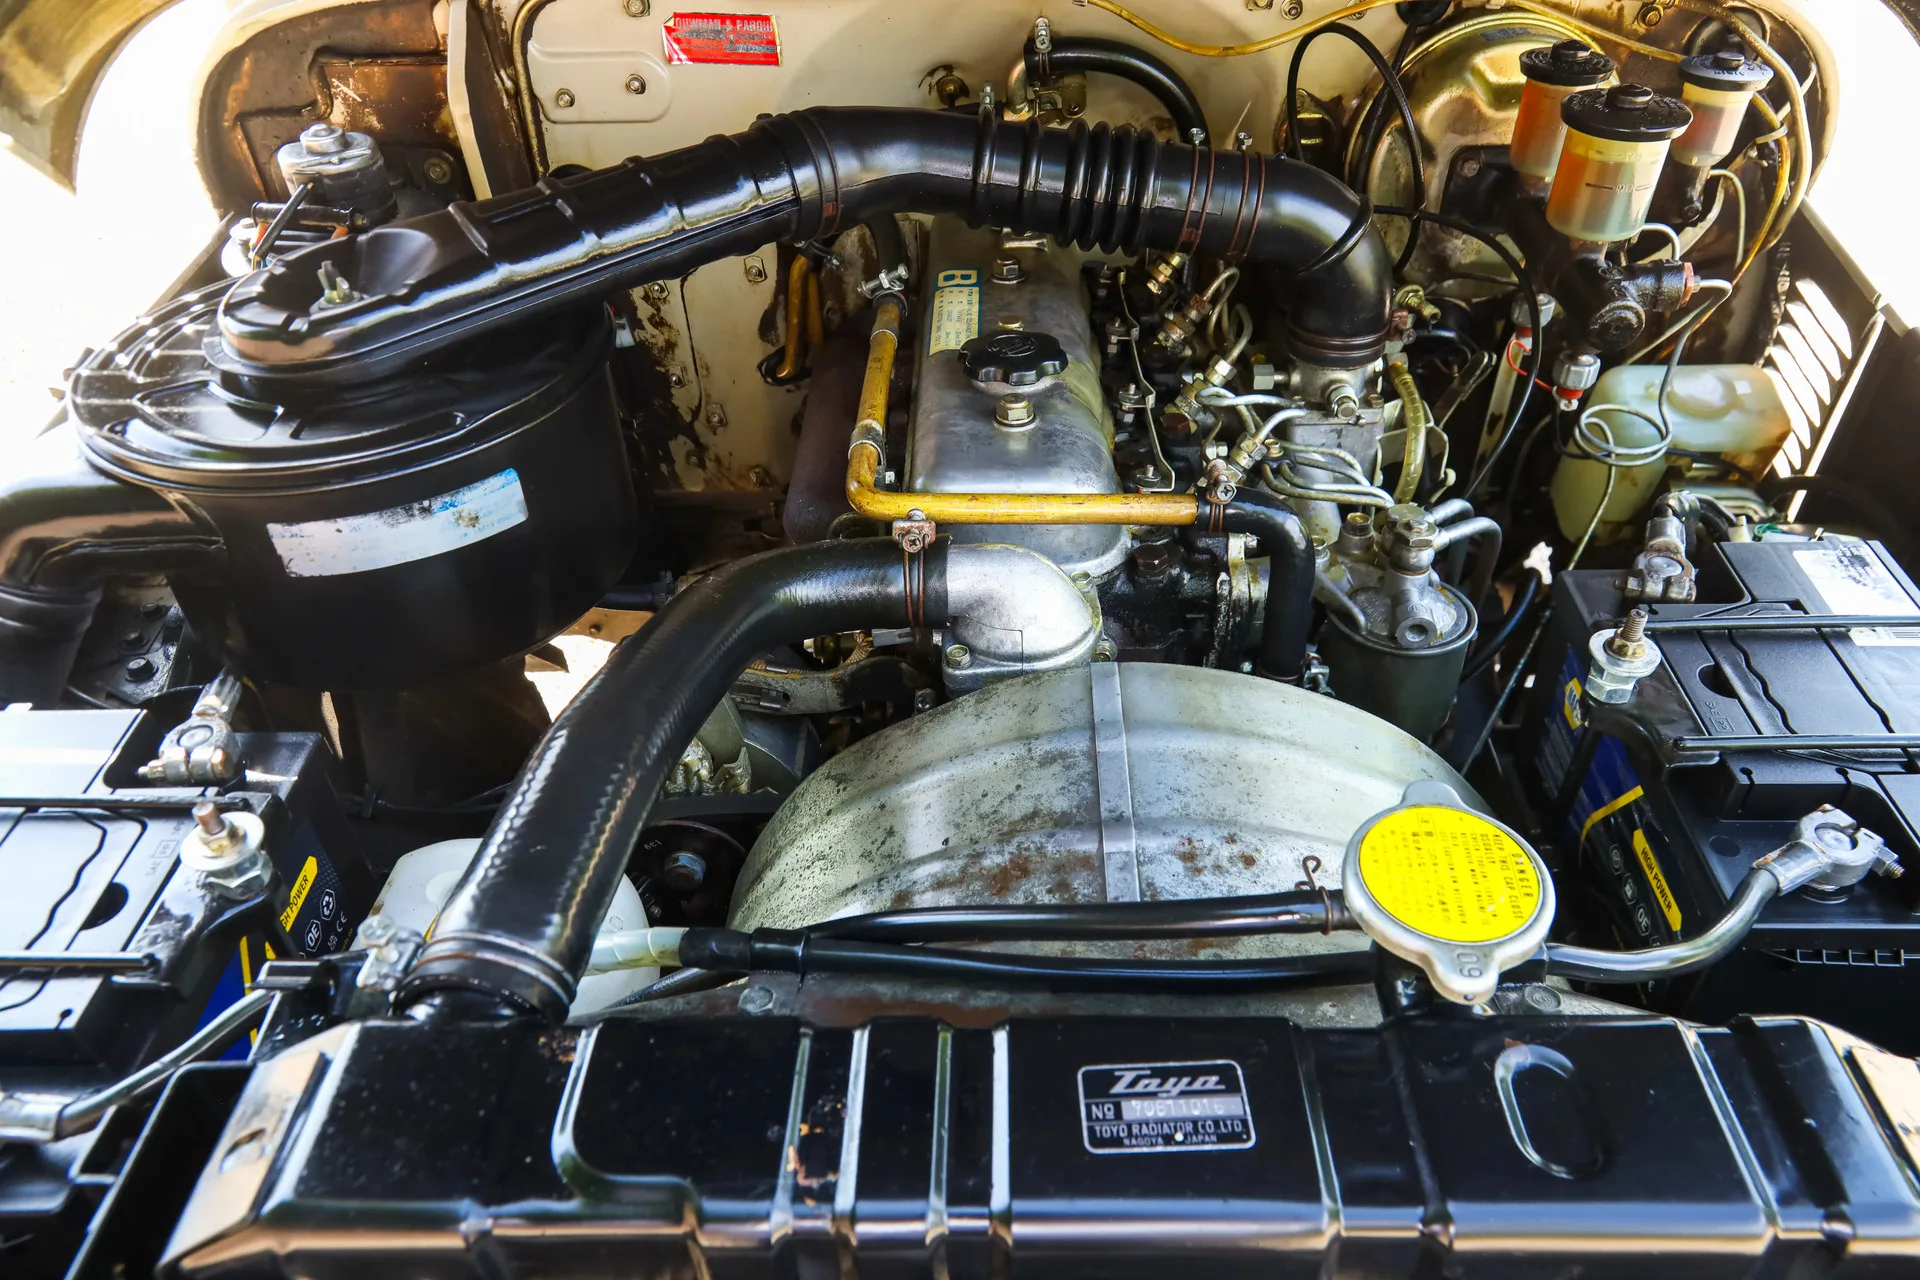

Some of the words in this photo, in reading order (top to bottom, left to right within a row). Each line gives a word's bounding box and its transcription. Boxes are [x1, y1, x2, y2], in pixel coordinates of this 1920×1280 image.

[1480, 833, 1496, 864] USUALLY
[1493, 834, 1505, 851] KEEP
[1498, 856, 1511, 871] THIS
[1504, 876, 1516, 891] CAP
[1511, 853, 1534, 898] DANGER
[1640, 847, 1655, 875] HIGH
[1652, 872, 1673, 912] POWER
[282, 913, 291, 927] GH
[288, 874, 310, 913] POWER
[1508, 894, 1525, 919] CLOSE
[1637, 909, 1650, 932] OE
[307, 924, 320, 947] OE
[1094, 1124, 1129, 1139] TOYO
[1131, 1121, 1194, 1137] RADIATOR
[1123, 1135, 1164, 1147] NAGOYA
[1185, 1134, 1218, 1145] JAPAN
